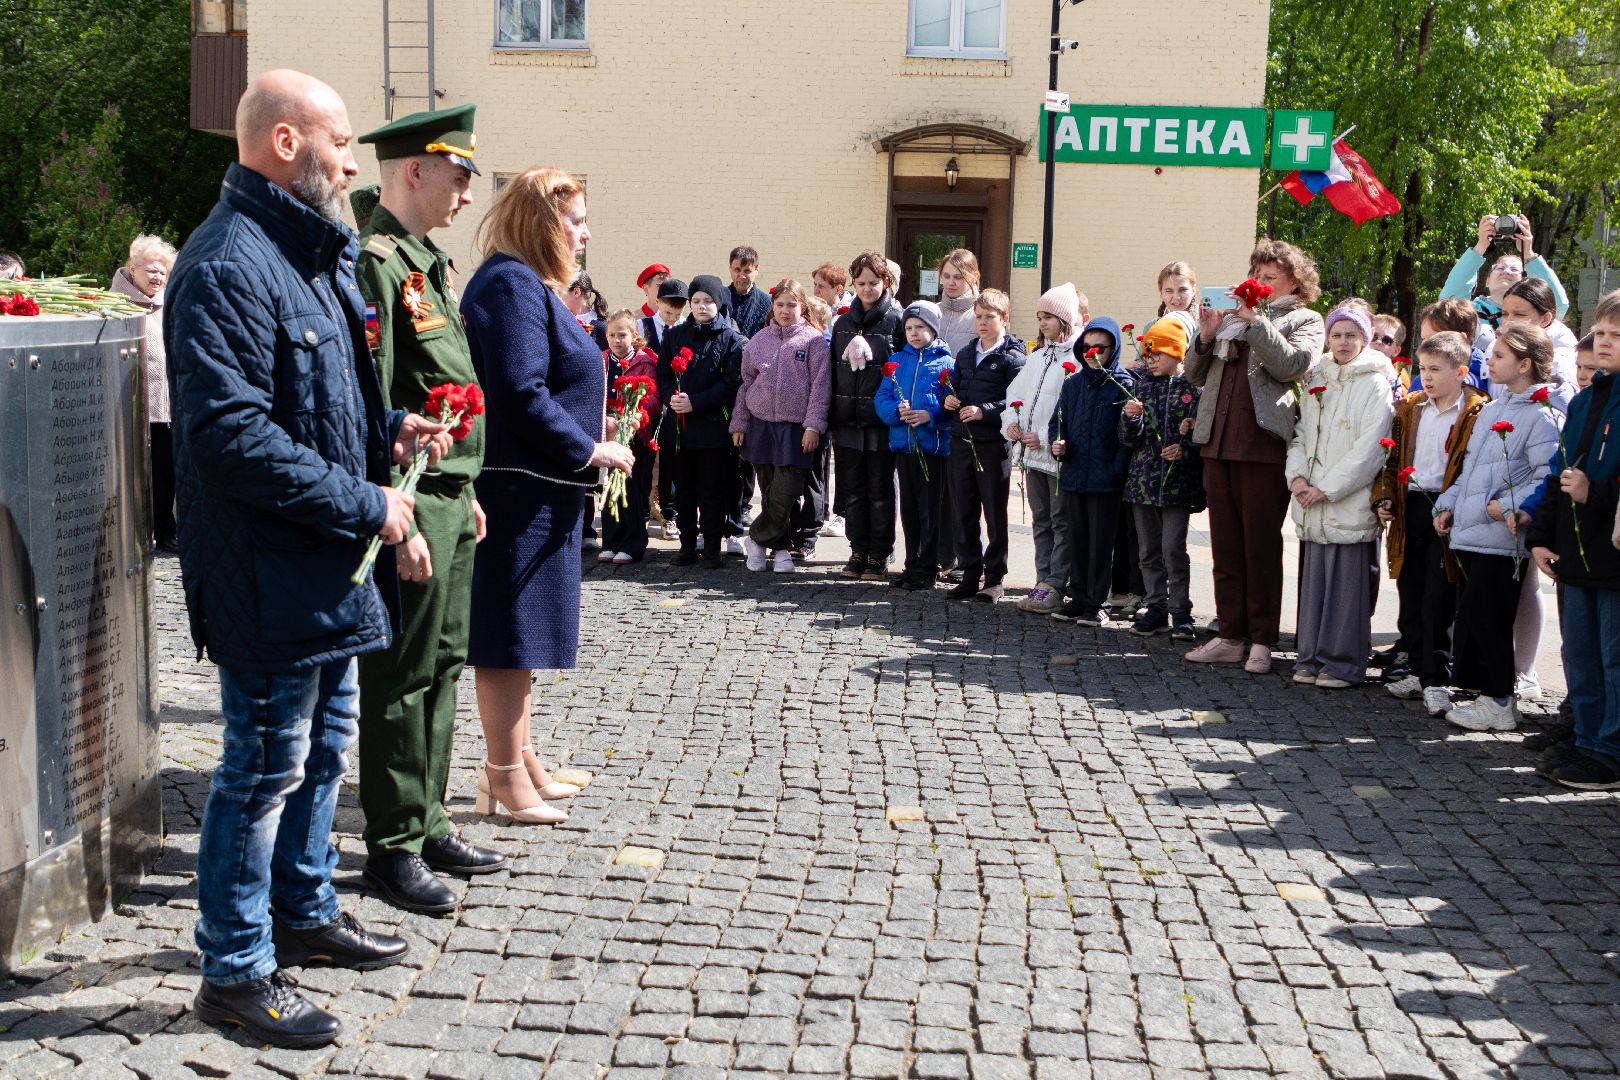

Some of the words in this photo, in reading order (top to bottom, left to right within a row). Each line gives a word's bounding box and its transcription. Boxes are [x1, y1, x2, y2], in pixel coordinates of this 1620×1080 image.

[1055, 115, 1251, 155] АПТЕКА
[51, 359, 86, 374] Аборин
[52, 378, 86, 391] Аборин
[52, 396, 87, 411] Аборин
[53, 415, 88, 430] Аборин
[53, 434, 88, 448] Аборин
[54, 451, 93, 468] Абрамов
[54, 470, 89, 486] Абызов
[55, 488, 88, 504] Авдеев
[55, 504, 104, 523] Аврамович
[56, 522, 100, 541] Агафонов
[56, 543, 90, 559] Акилов
[57, 575, 99, 596] Алиханов
[58, 594, 96, 615] Андреев
[58, 613, 92, 632] Анохин
[59, 624, 107, 650] Антоненко
[59, 641, 107, 669] Антоненко
[60, 659, 108, 688] Антоненко
[61, 681, 99, 705] Аржанов
[61, 692, 110, 723] Артамонов
[62, 733, 100, 759] Астахов
[62, 746, 106, 776] Асташкин
[63, 762, 110, 794] Афанасьев
[63, 785, 100, 811] Ахапкин
[63, 799, 105, 830] Ахмадеев
